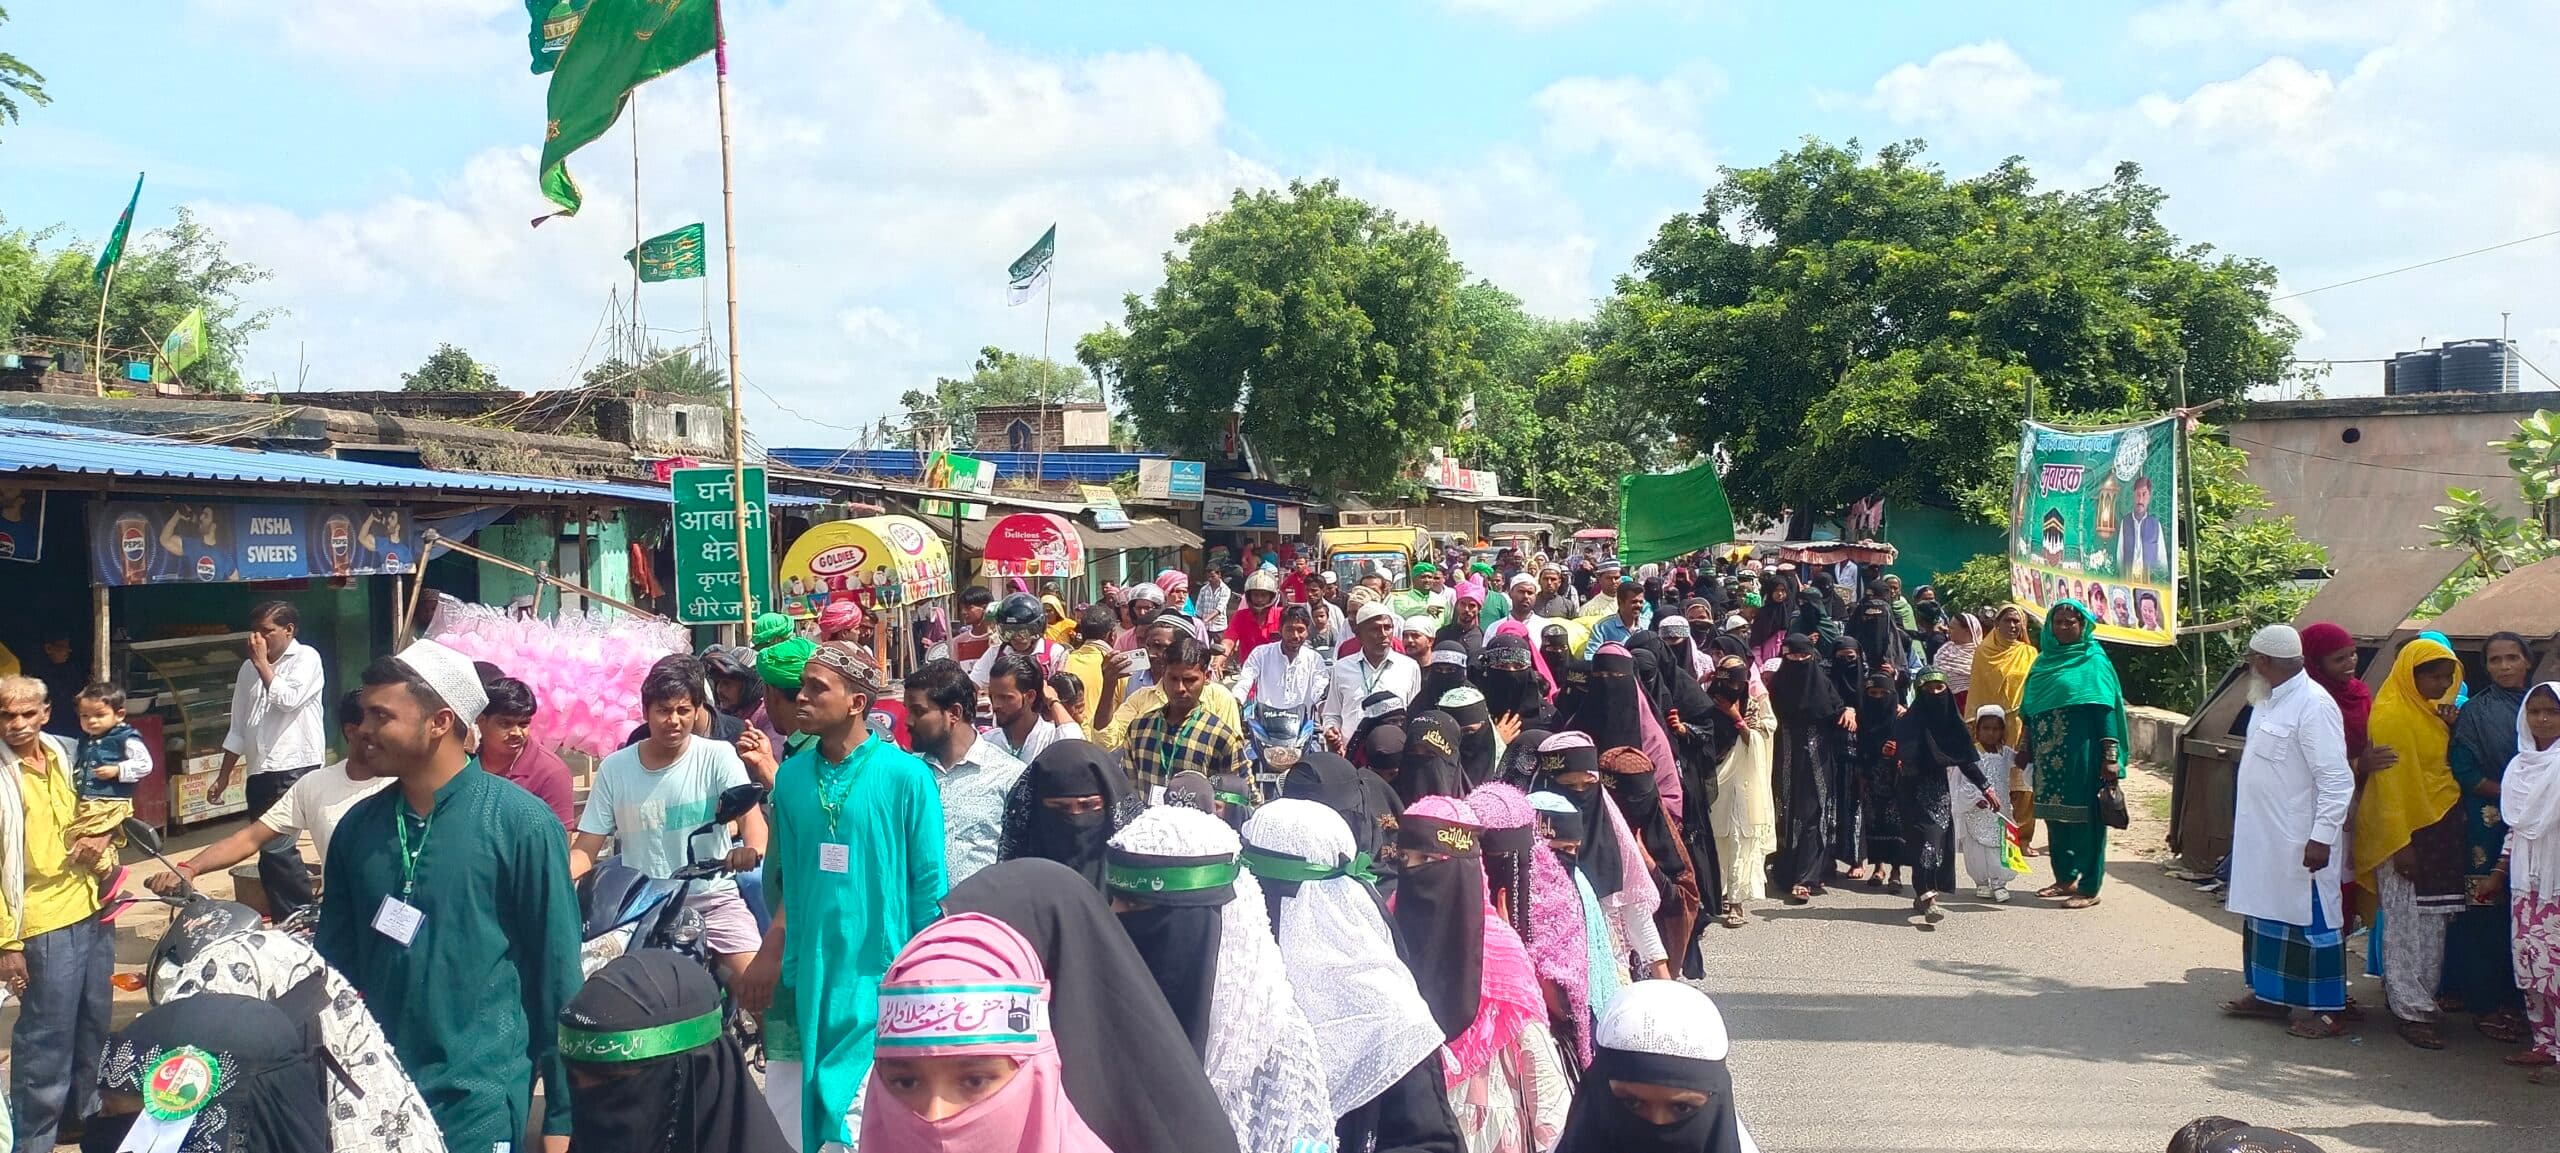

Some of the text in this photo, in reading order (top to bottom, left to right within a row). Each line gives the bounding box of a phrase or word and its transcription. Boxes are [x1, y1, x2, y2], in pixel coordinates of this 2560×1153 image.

[250, 517, 292, 535] AYSHA
[1004, 531, 1040, 539] Delicious
[123, 539, 144, 550] PEPSI
[247, 545, 297, 563] SWEETS
[819, 550, 856, 568] GOLDIEE
[688, 596, 719, 617] धीरे
